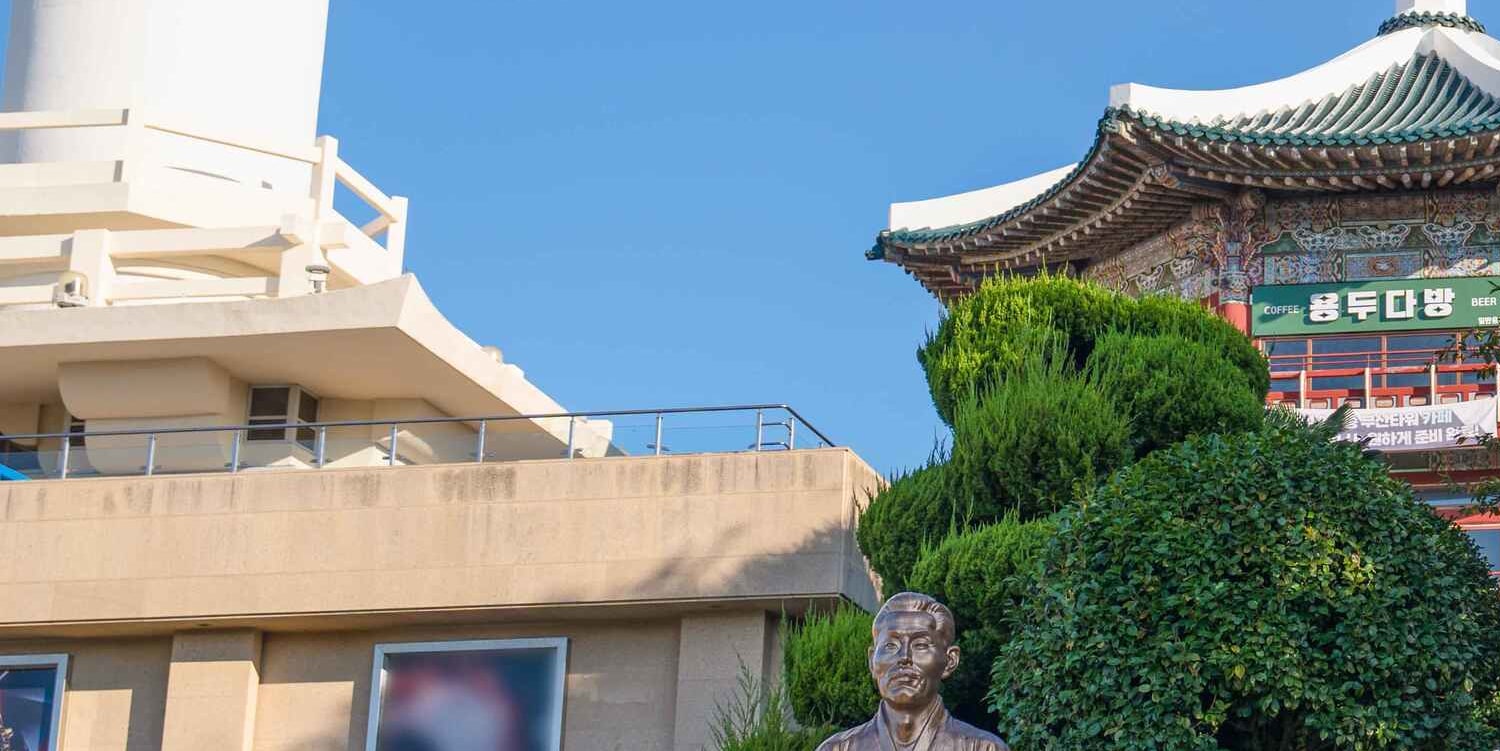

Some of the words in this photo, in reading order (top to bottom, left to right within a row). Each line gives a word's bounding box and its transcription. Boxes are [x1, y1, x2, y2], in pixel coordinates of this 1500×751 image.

[1264, 304, 1300, 315] COFFEE
[1309, 288, 1456, 322] 용두다방
[1471, 297, 1497, 307] BEER
[1361, 411, 1419, 429] 부산타워
[1423, 409, 1452, 425] 카페
[1415, 427, 1443, 445] 준비
